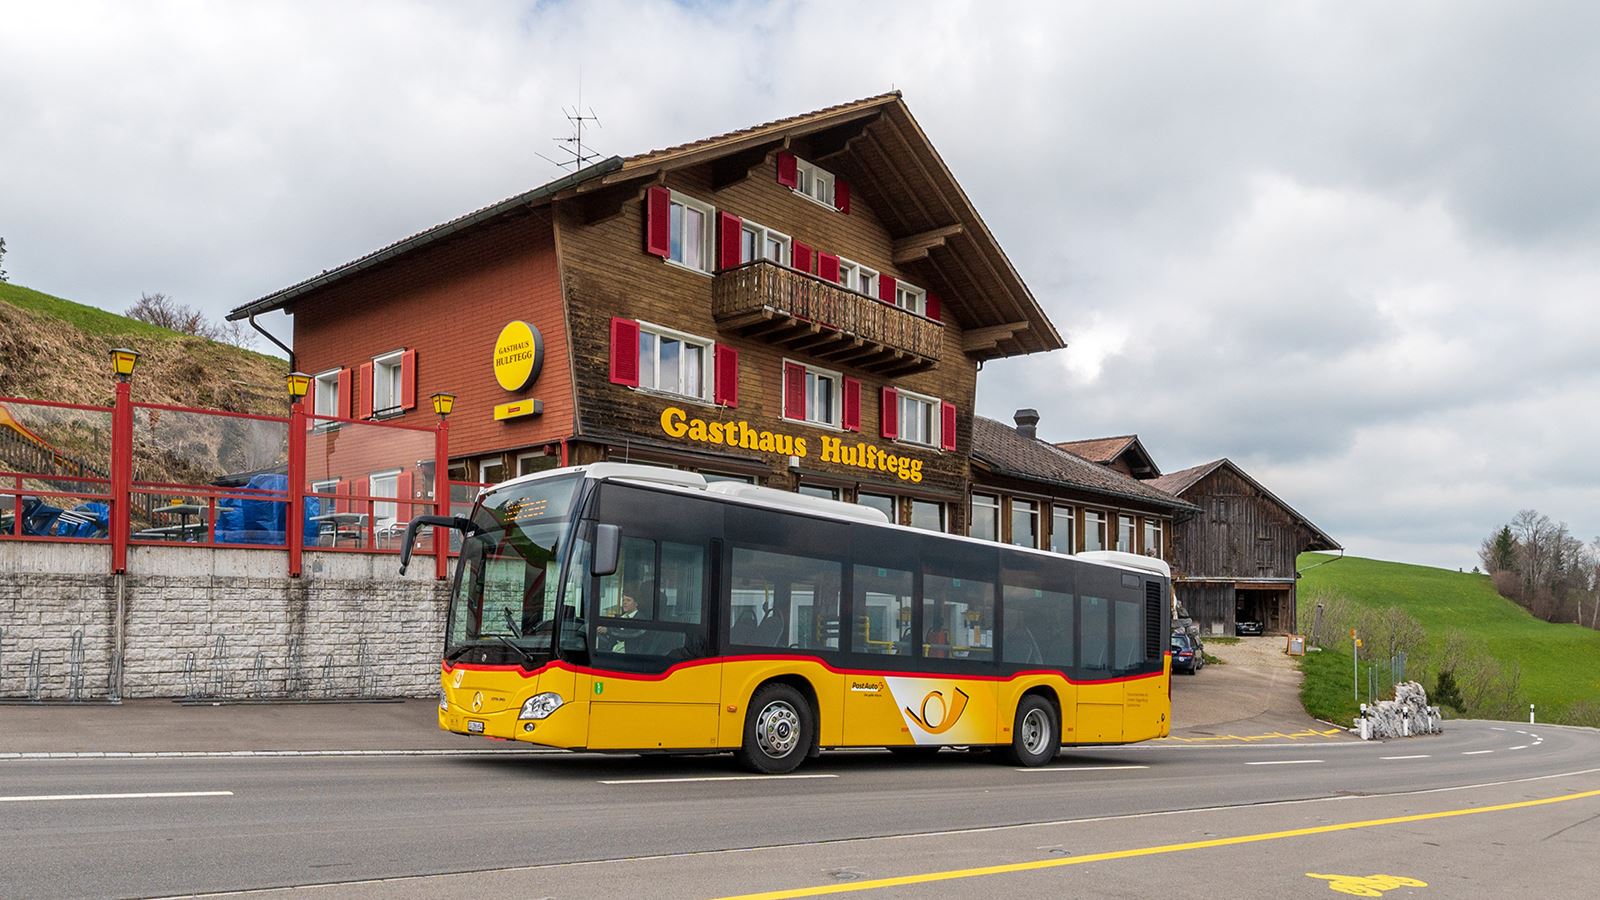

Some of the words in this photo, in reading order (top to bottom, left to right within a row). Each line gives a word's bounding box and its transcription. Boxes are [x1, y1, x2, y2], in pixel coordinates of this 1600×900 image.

[498, 341, 530, 355] GASTHAUS
[496, 350, 532, 367] HULFTEGG
[660, 407, 807, 457] Gasthaus
[820, 436, 923, 483] Hulftegg
